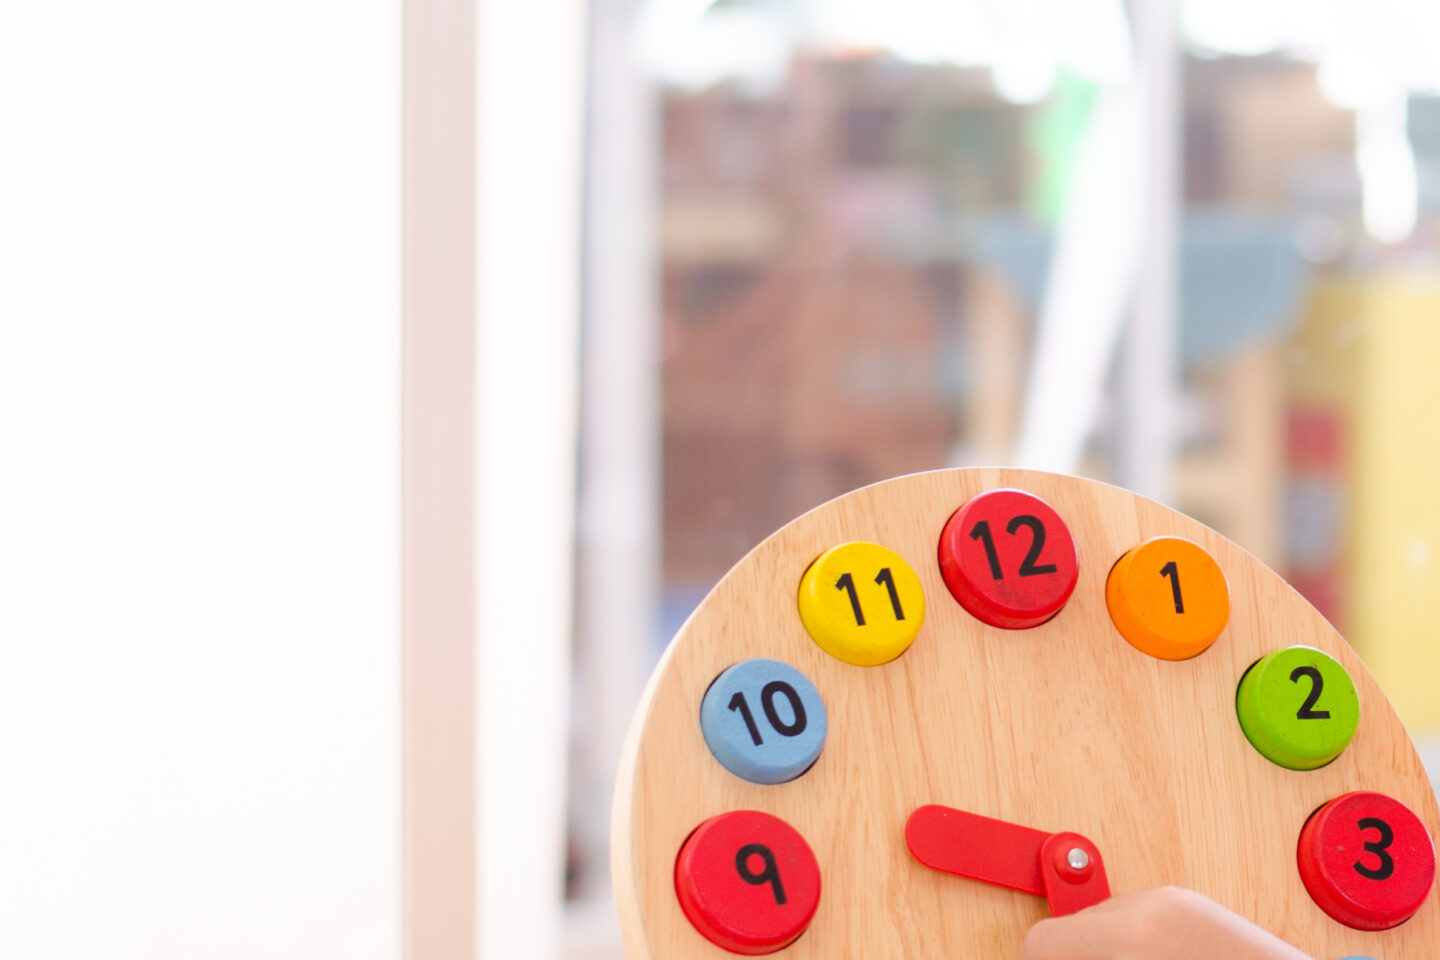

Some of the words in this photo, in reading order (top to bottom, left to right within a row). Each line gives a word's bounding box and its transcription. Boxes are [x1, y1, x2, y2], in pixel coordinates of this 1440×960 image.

[969, 514, 1058, 581] 12
[834, 567, 905, 627] 11
[1159, 561, 1185, 615] 1
[727, 679, 808, 747] 10
[1288, 665, 1332, 721] 2
[734, 843, 787, 906] 9
[1352, 816, 1395, 882] 3
